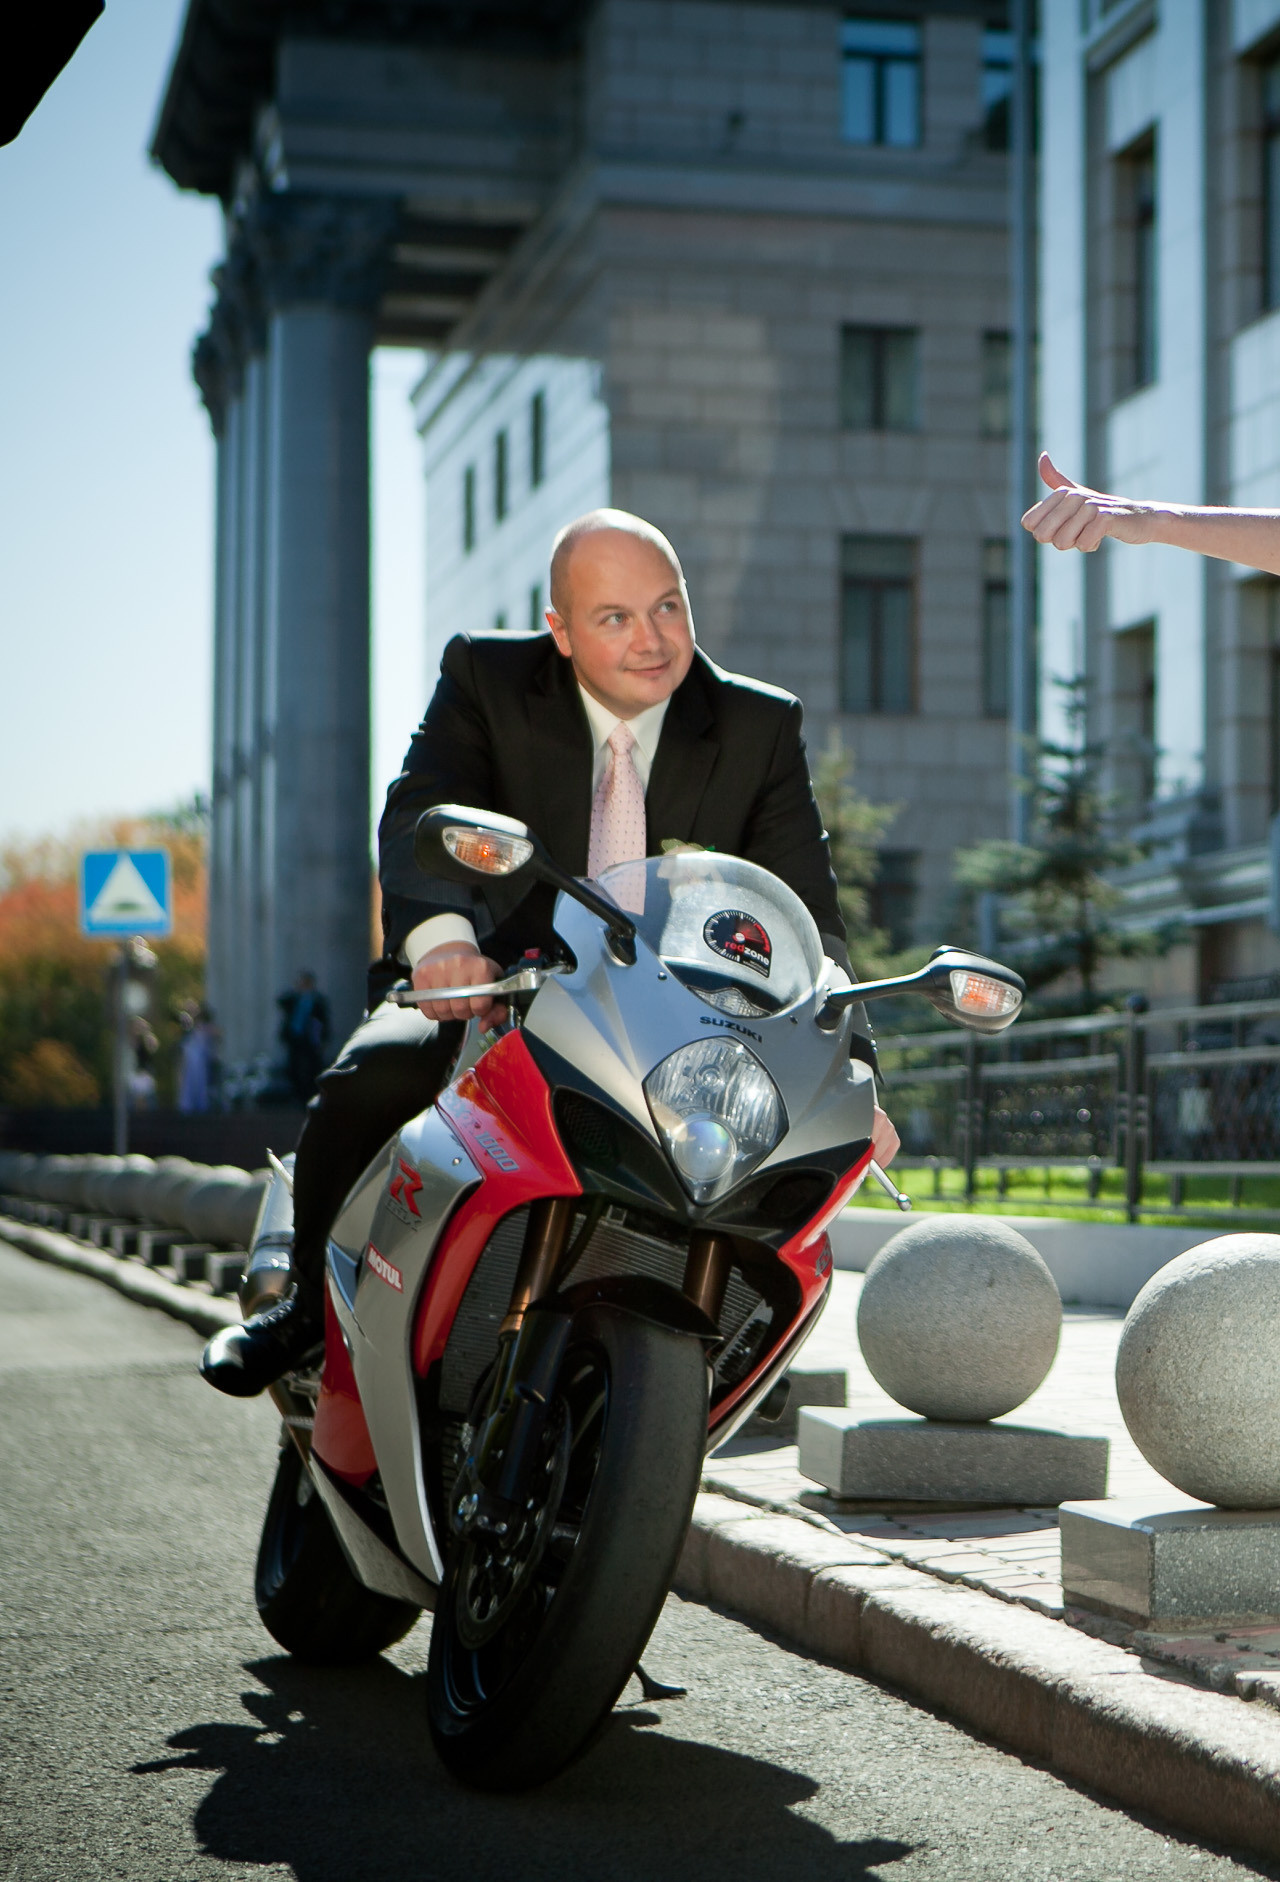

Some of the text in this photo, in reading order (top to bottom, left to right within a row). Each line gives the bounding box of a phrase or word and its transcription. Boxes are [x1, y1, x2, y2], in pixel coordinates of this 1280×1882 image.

[700, 1016, 762, 1043] SUZUKI
[475, 1131, 519, 1171] 1000
[367, 1248, 402, 1289] MOTUL
